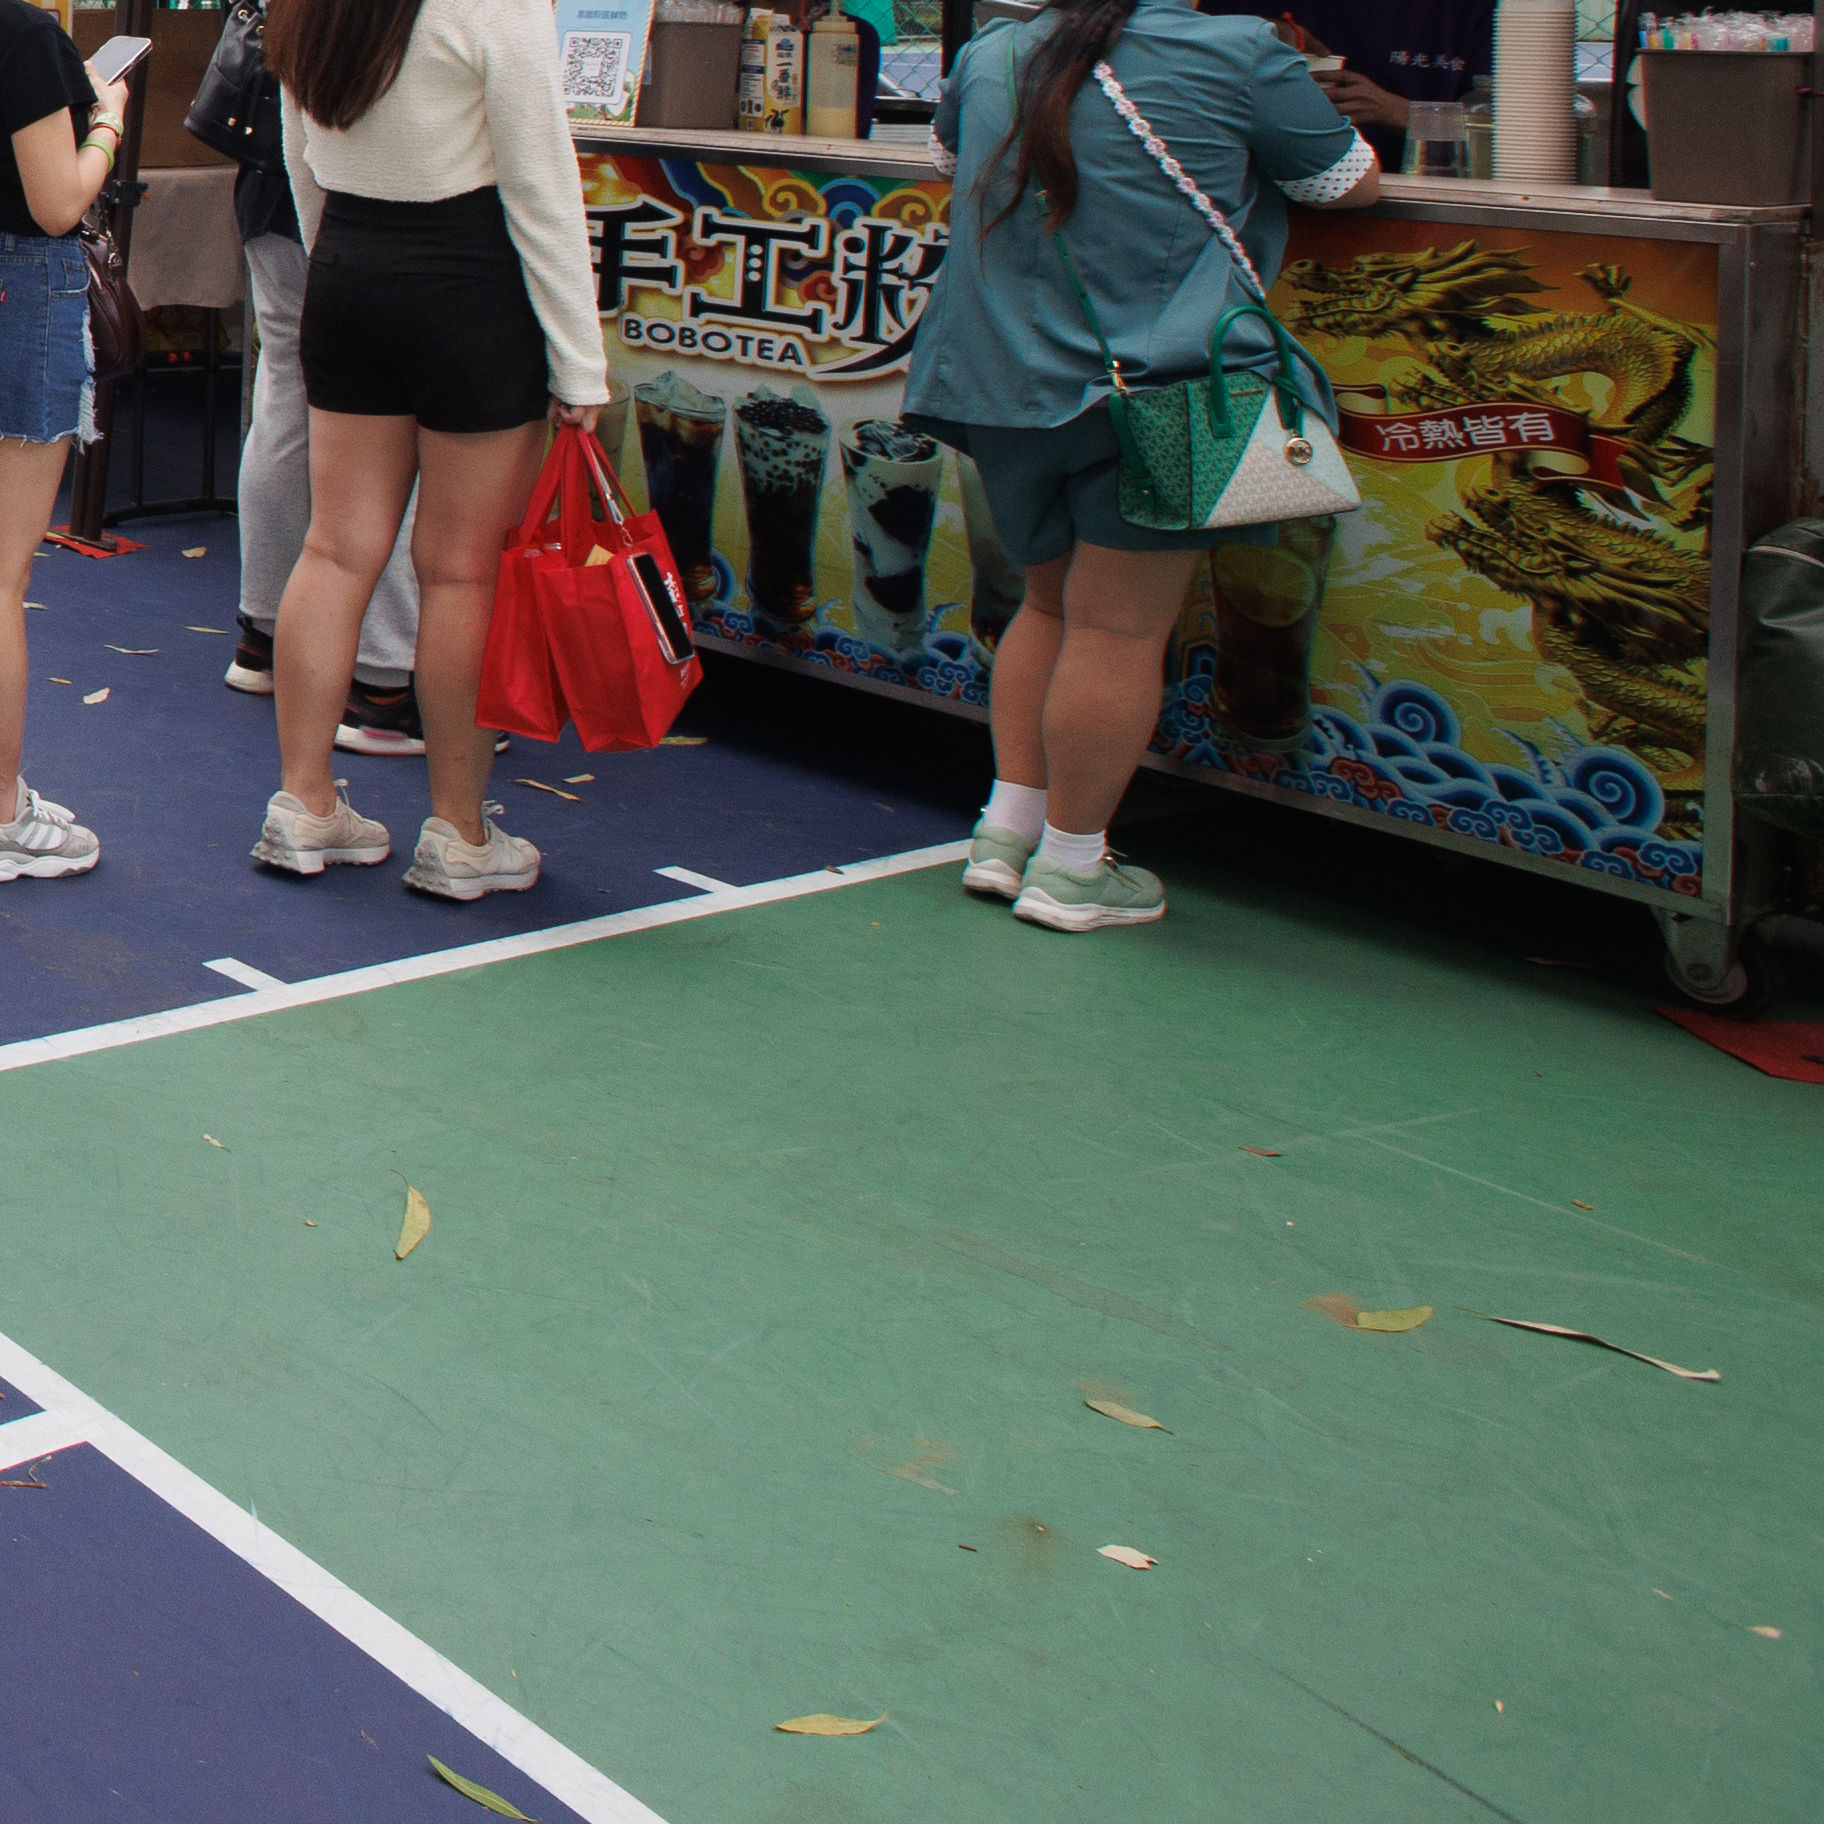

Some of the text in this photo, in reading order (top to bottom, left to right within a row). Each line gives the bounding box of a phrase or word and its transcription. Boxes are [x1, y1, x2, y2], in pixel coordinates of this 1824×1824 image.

[622, 318, 803, 366] BOBOTEA
[1374, 412, 1556, 451] 冷熱皆有
